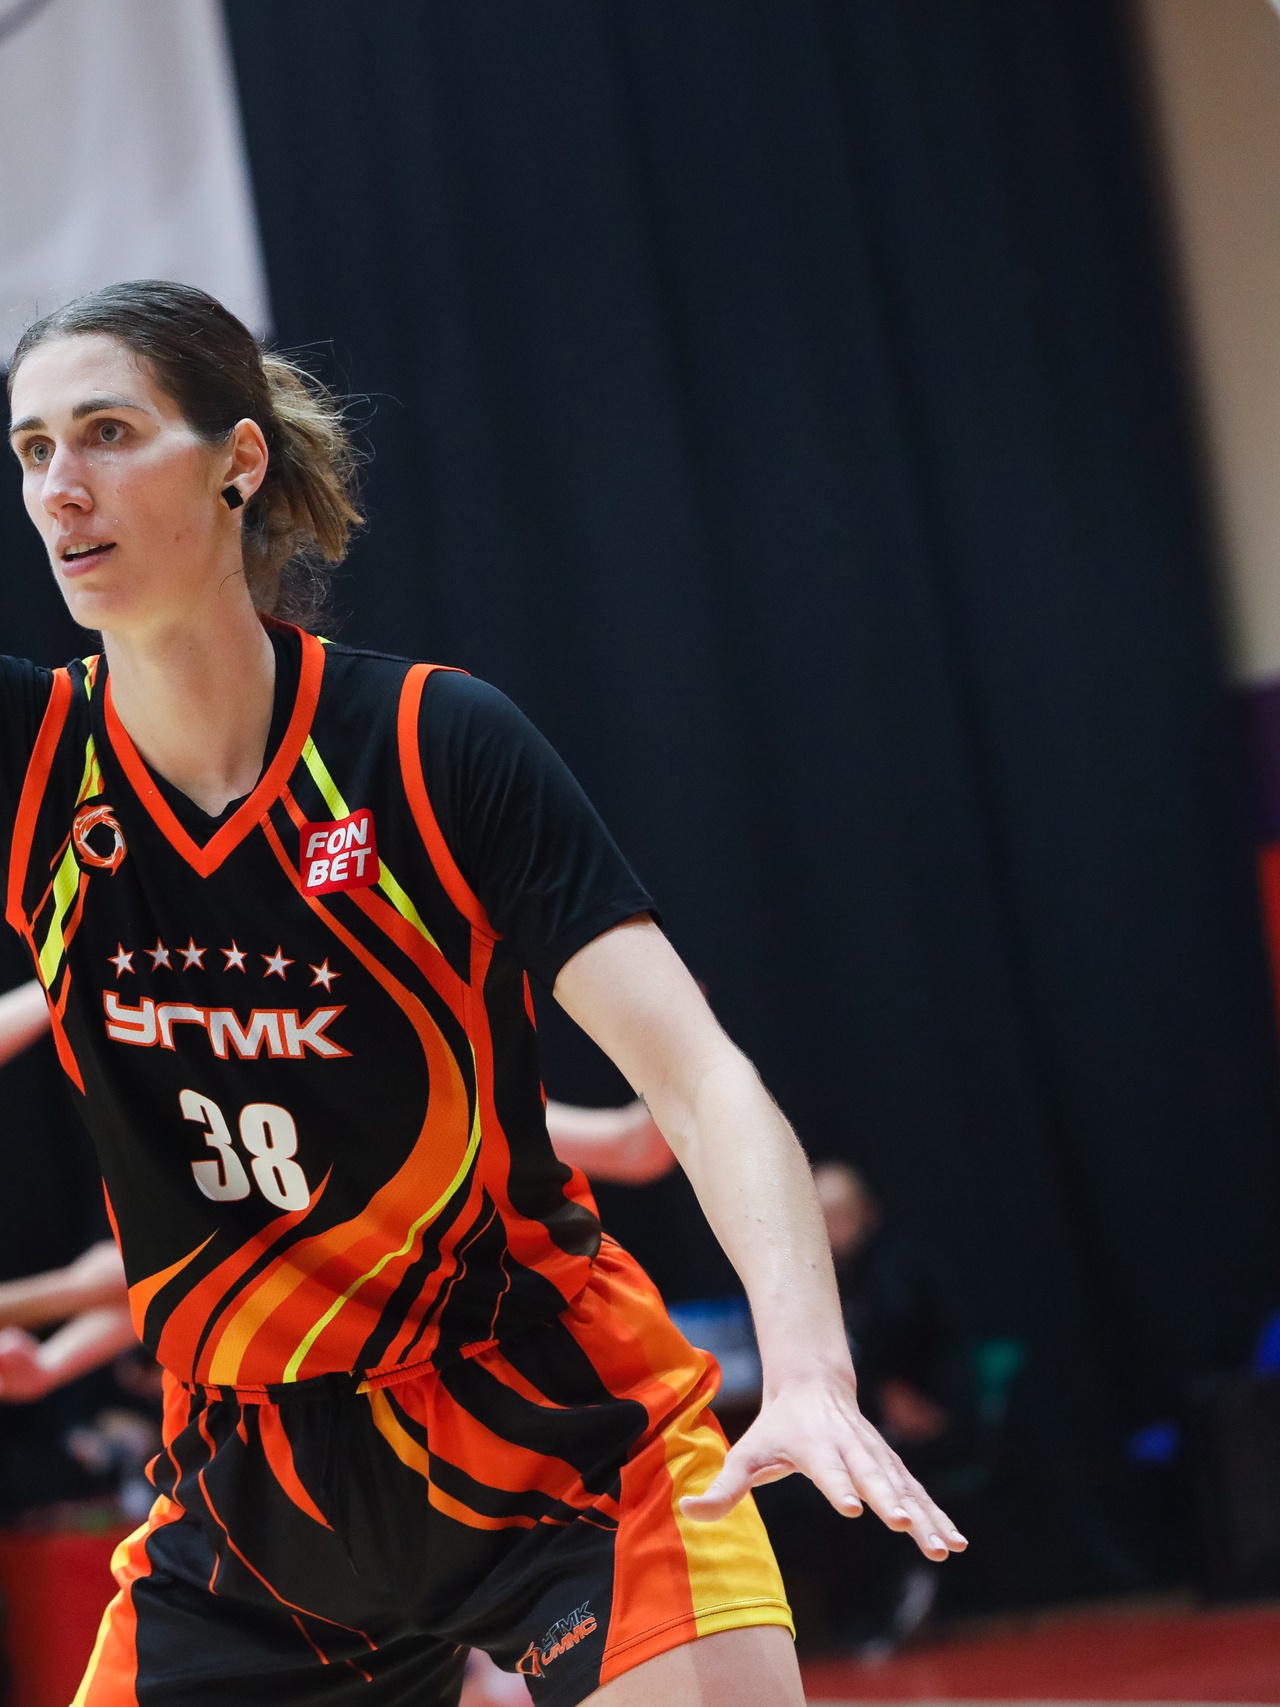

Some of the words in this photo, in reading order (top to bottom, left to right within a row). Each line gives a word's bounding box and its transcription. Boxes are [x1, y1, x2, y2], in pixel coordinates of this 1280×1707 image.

[306, 817, 368, 858] FON
[307, 847, 372, 887] BET
[103, 990, 354, 1060] УГМК
[179, 1088, 311, 1212] 38
